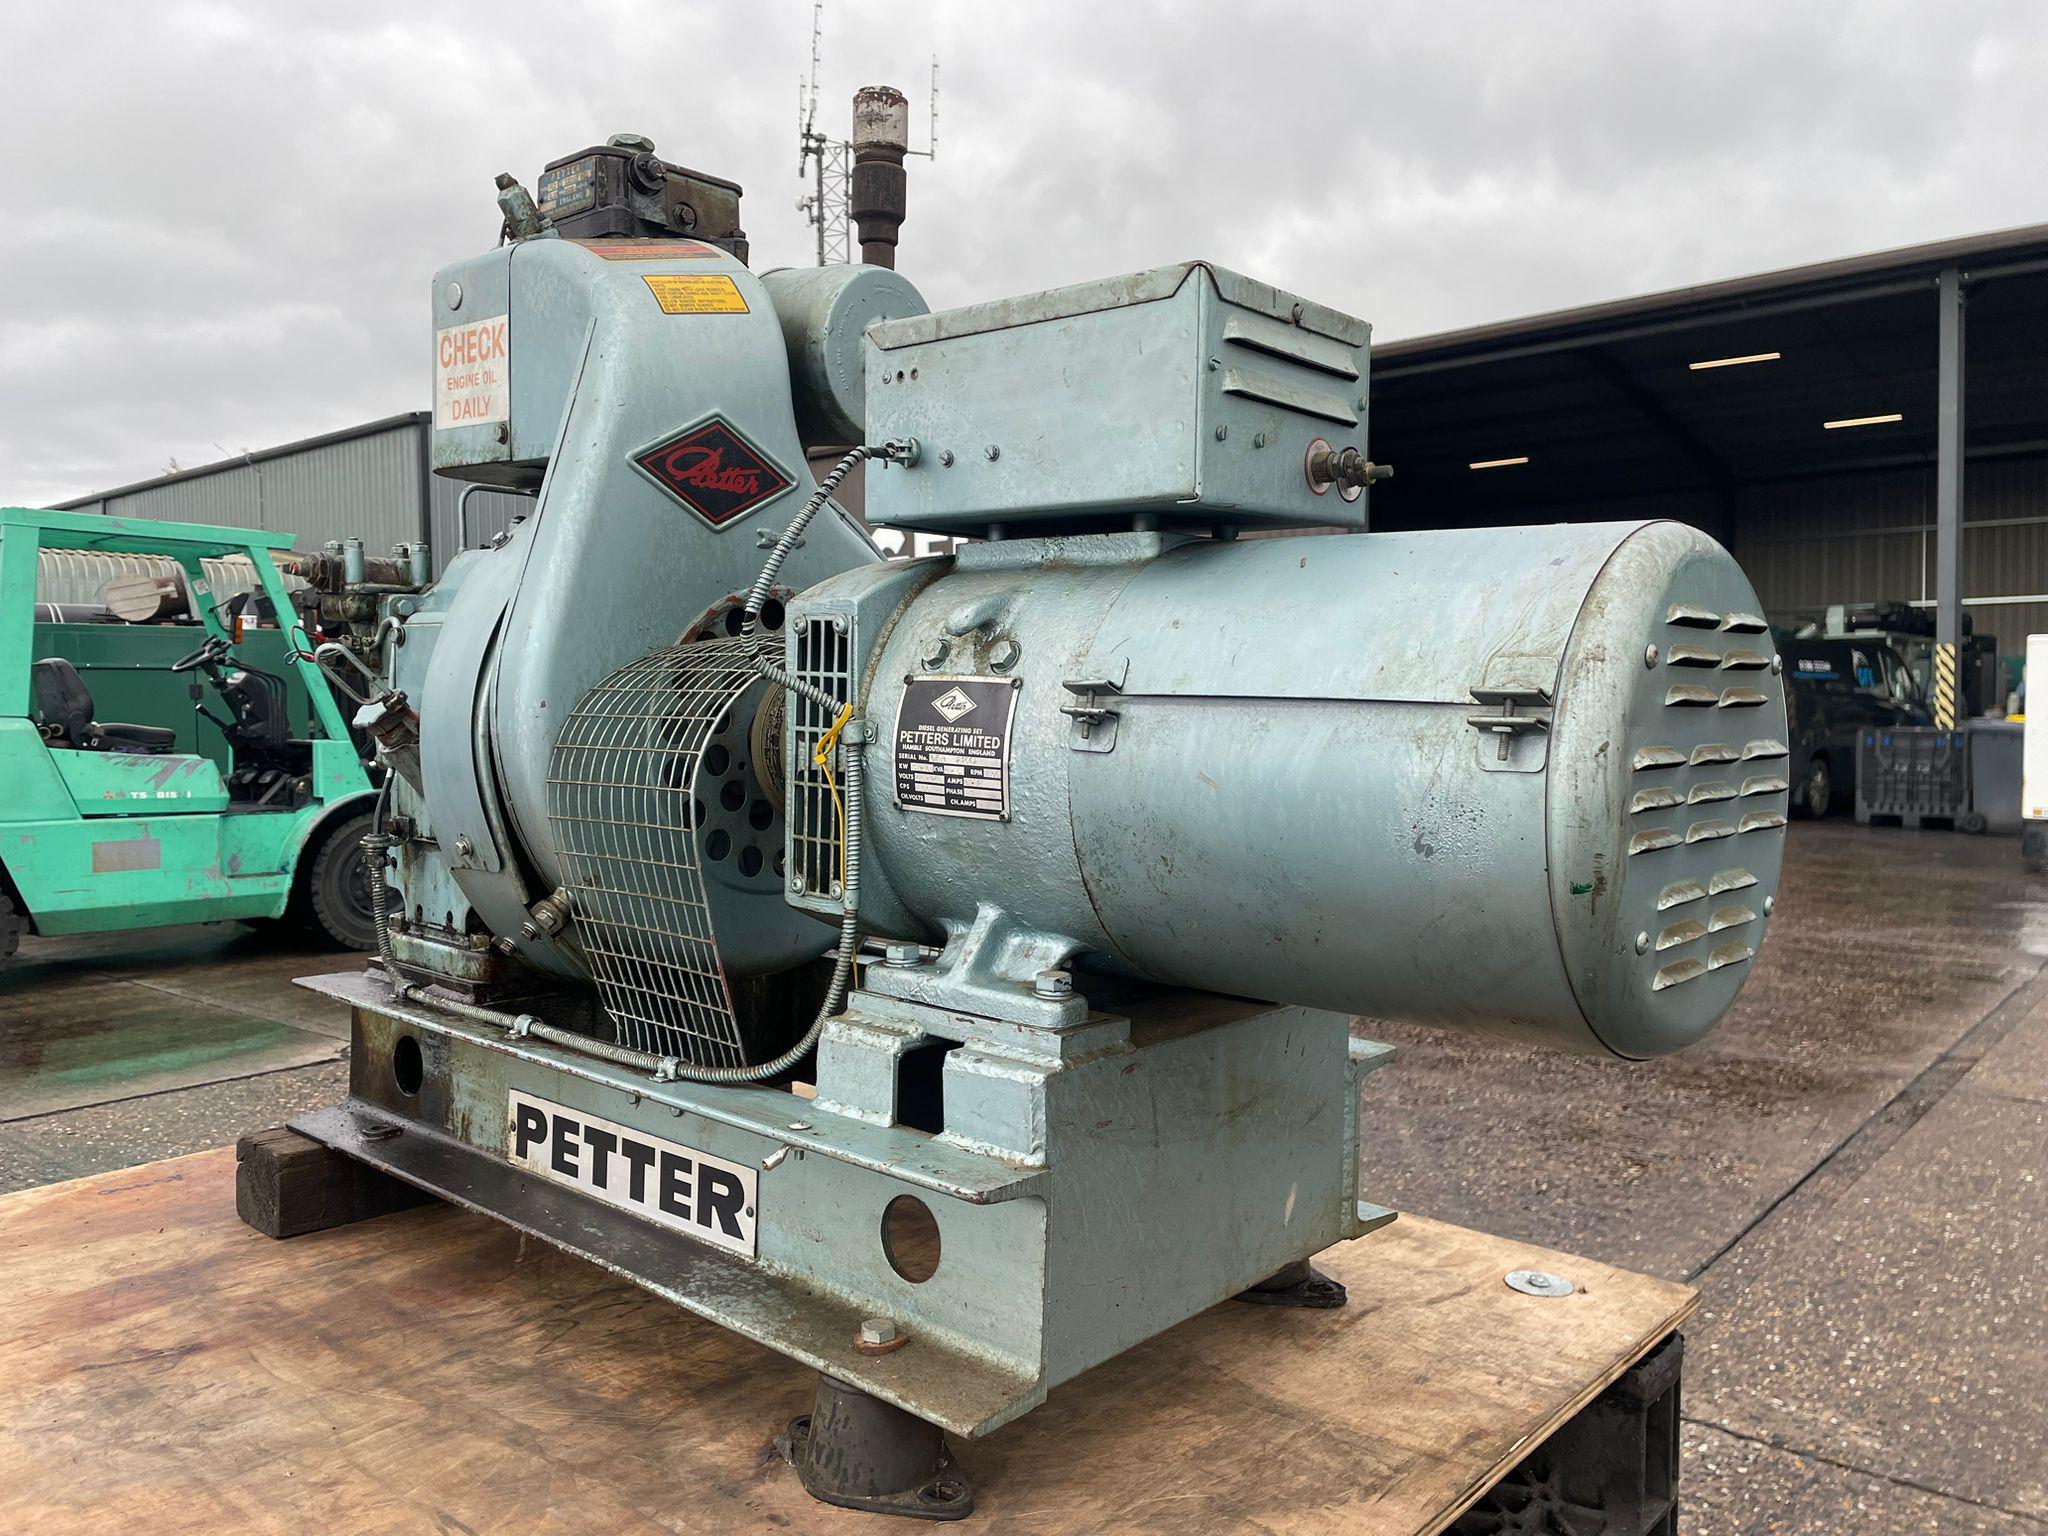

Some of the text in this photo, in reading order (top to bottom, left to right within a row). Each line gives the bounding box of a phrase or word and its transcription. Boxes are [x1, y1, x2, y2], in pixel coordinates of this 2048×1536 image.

[440, 323, 506, 369] CHECK
[447, 370, 497, 391] ENGINE OIL
[452, 396, 491, 420] DAILY
[665, 447, 761, 494] Petter
[900, 730, 1001, 749] PETTERS LIMITED
[936, 726, 972, 734] GENERATING
[898, 752, 917, 760] SERIAL
[925, 745, 965, 754] SOUTHAMPTON
[968, 749, 996, 757] ENGLAND
[516, 1102, 745, 1241] PETTER
